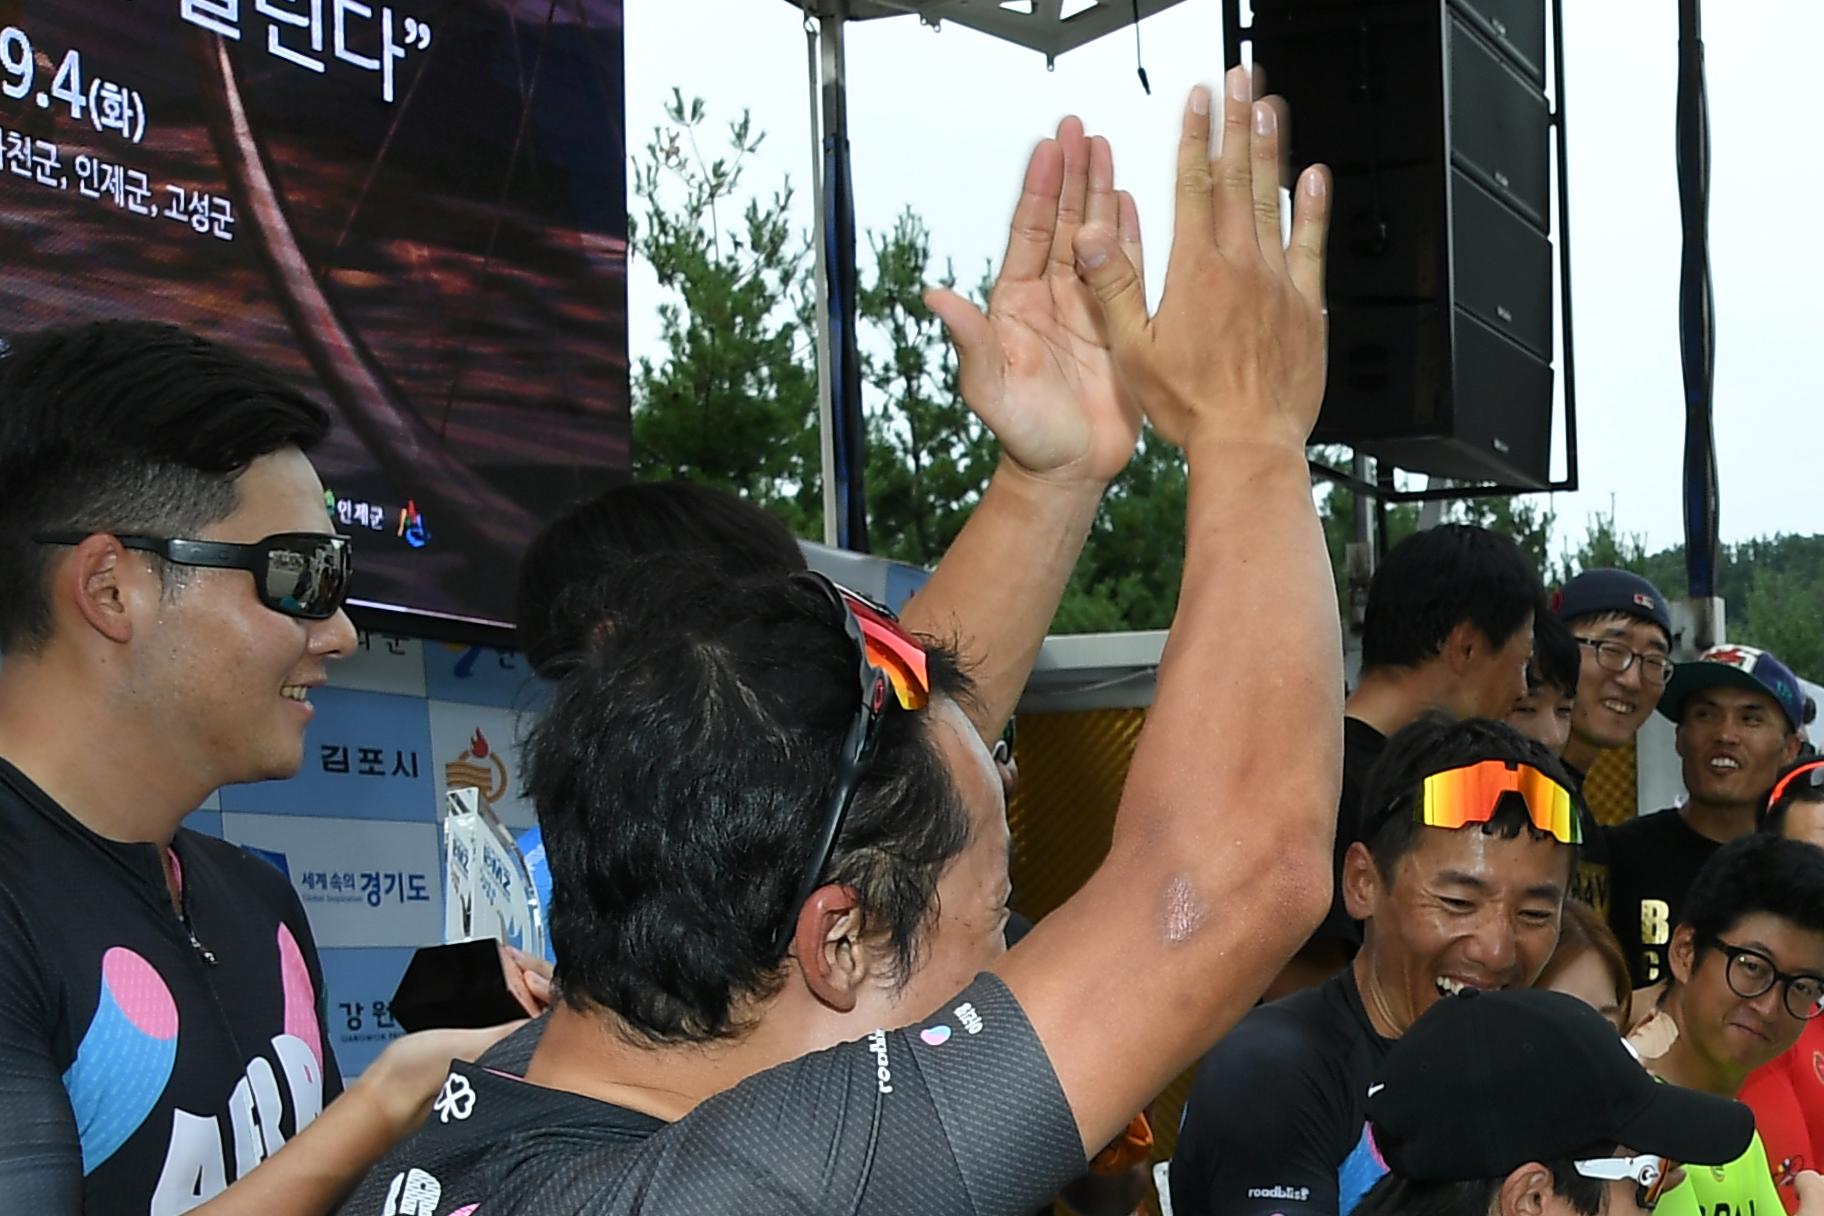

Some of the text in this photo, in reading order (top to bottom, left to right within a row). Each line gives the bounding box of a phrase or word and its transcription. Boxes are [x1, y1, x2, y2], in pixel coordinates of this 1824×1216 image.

[74, 154, 159, 218] 인제군,
[163, 184, 236, 241] 고성군
[337, 499, 384, 531] 인제군
[320, 744, 419, 779] 김포시
[360, 870, 431, 908] 경기도
